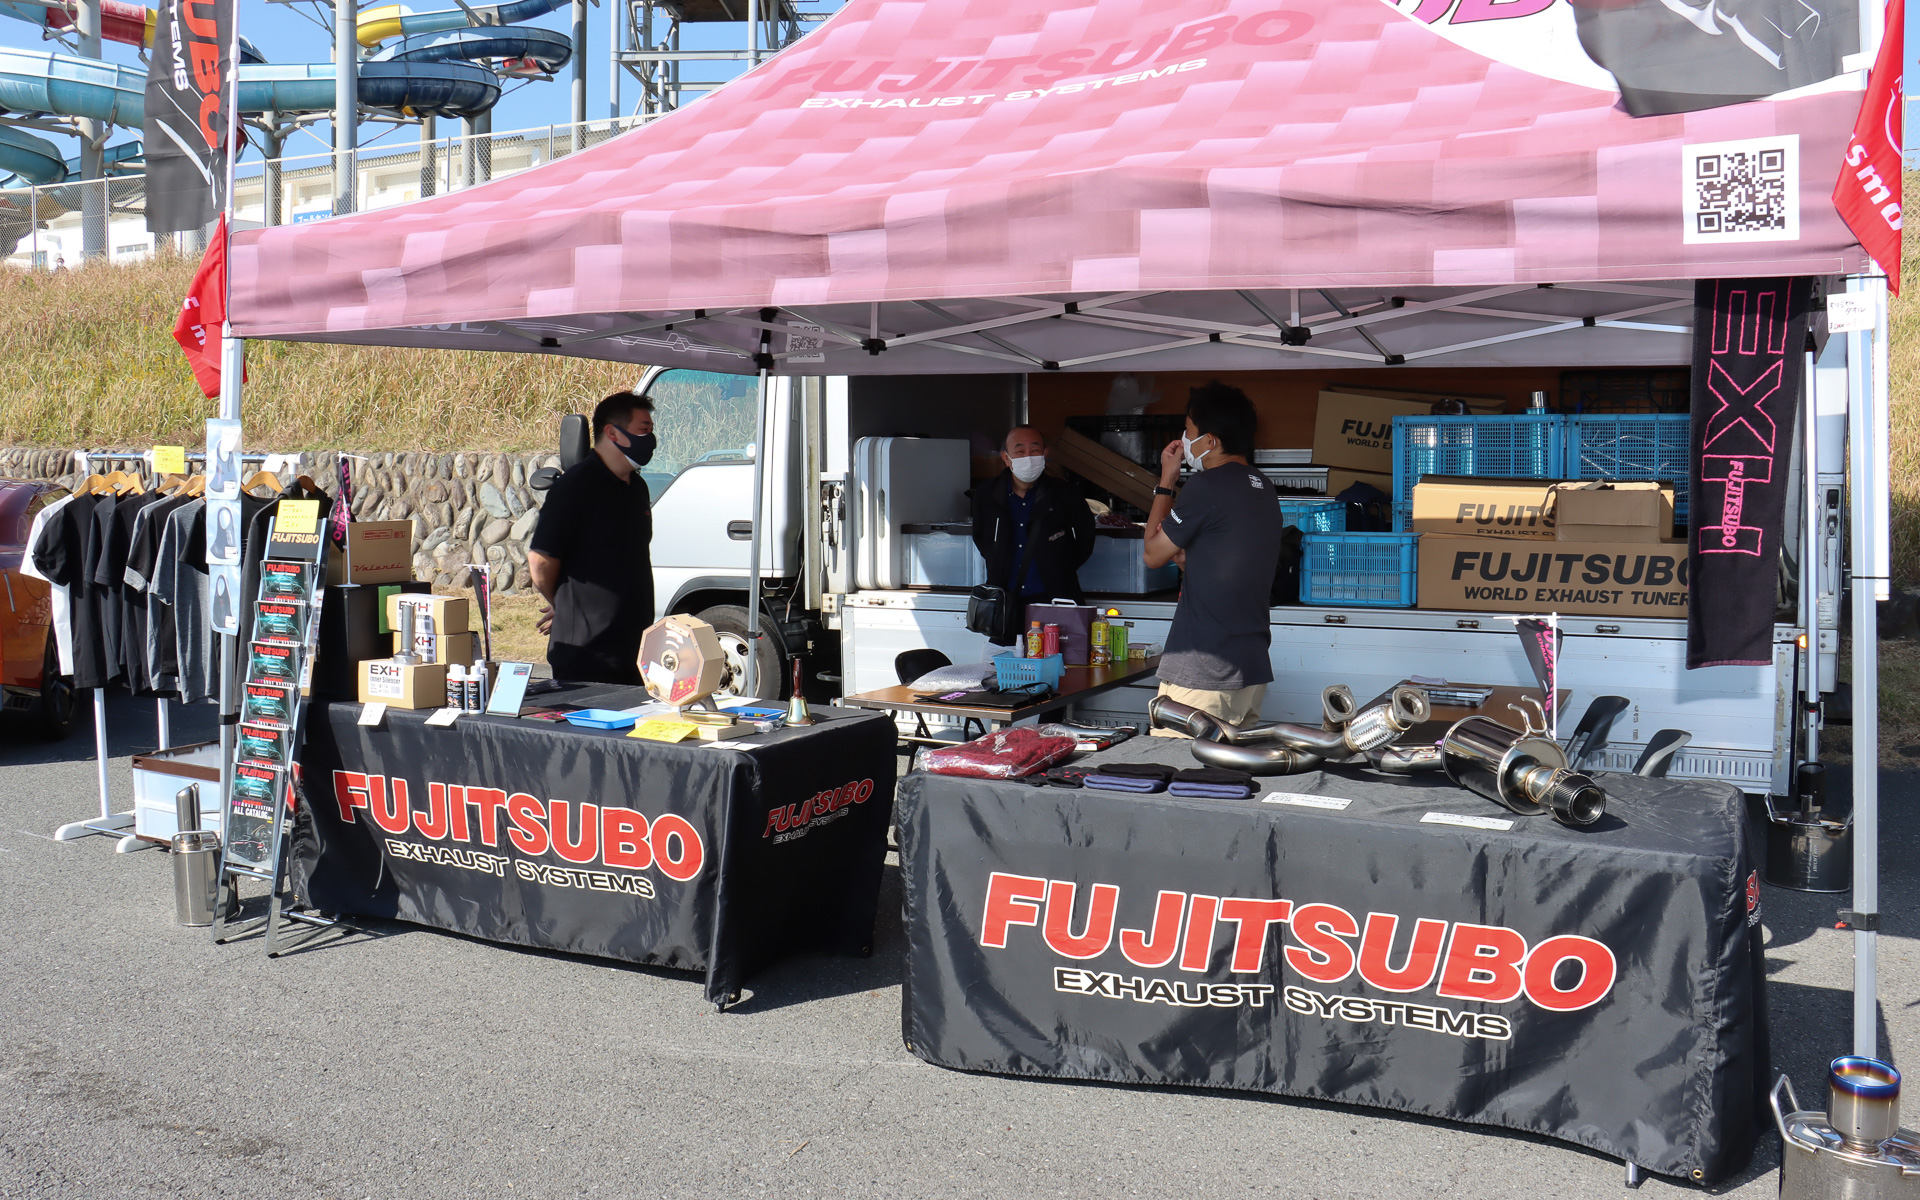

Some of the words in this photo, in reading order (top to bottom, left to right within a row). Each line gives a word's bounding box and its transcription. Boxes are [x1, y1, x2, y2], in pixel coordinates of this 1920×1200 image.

[753, 10, 1316, 100] FUJITSUBO
[799, 93, 996, 109] EXHAUST
[1003, 57, 1209, 102] SYSTEMS
[1347, 436, 1380, 448] WORLD
[1720, 459, 1745, 548] FUJITSUBO
[270, 532, 320, 545] FUJITSUBO
[352, 562, 405, 572] Valenti
[1464, 586, 1529, 602] WORLD
[1535, 588, 1624, 605] EXHAUST
[237, 766, 275, 780] FUJITSUBO
[233, 805, 245, 816] ALL
[333, 769, 704, 882] FUJITSUBO
[384, 838, 510, 877] EXHAUST
[515, 859, 656, 899] SYSTEMS
[980, 872, 1617, 1012] FUJITSUBO
[1054, 967, 1273, 1007] EXHAUST
[1284, 985, 1512, 1041] SYSTEMS
